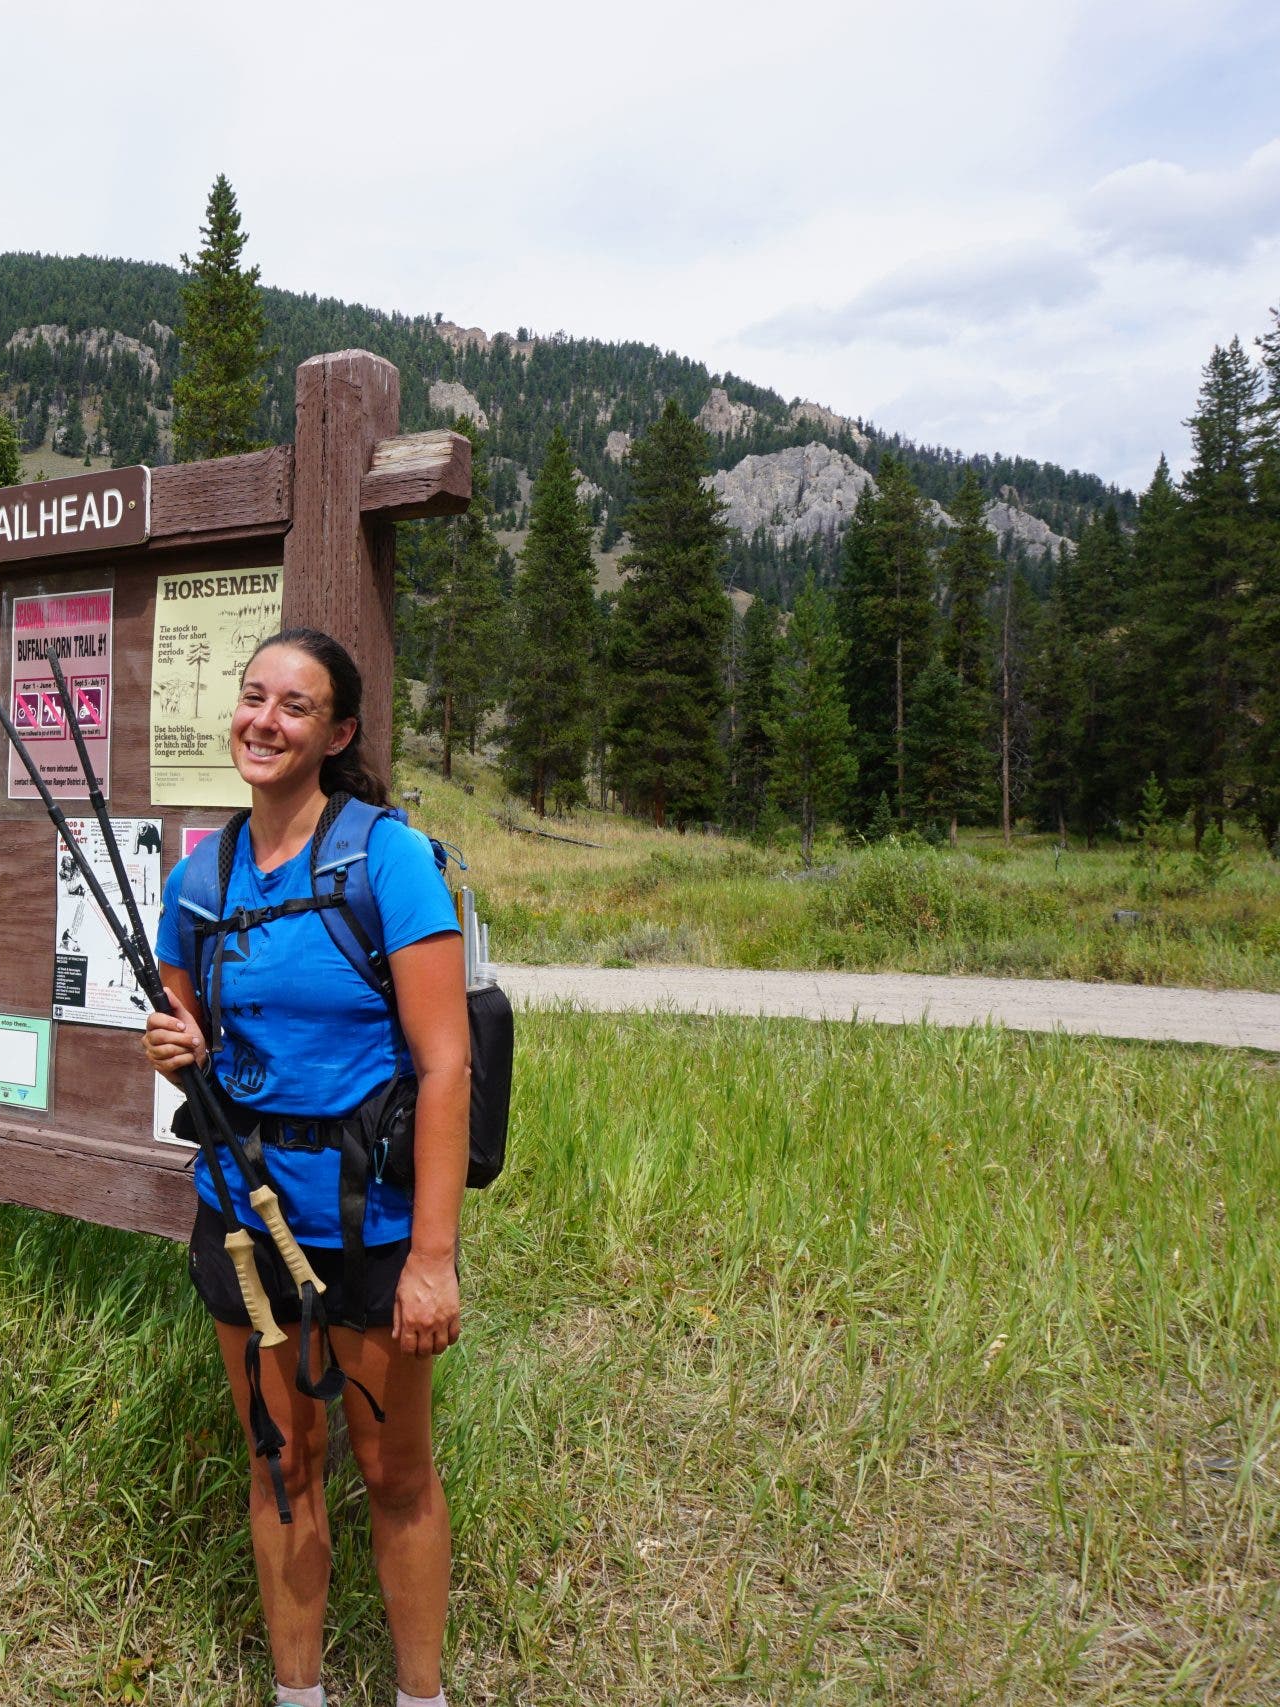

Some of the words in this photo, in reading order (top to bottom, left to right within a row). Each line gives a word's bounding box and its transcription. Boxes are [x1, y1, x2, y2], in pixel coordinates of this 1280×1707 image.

[163, 573, 278, 600] HORSEMEN
[172, 624, 190, 632] stock
[179, 632, 188, 640] for
[190, 632, 206, 640] short
[18, 638, 48, 662] BUFFALO
[74, 634, 96, 658] TRAIL
[98, 634, 106, 656] #1
[158, 648, 184, 658] periods
[197, 741, 207, 750] for
[154, 749, 176, 758] longer
[178, 748, 204, 758] periods.
[53, 778, 66, 787] Ranger
[67, 778, 80, 786] District
[2, 1019, 13, 1027] stop
